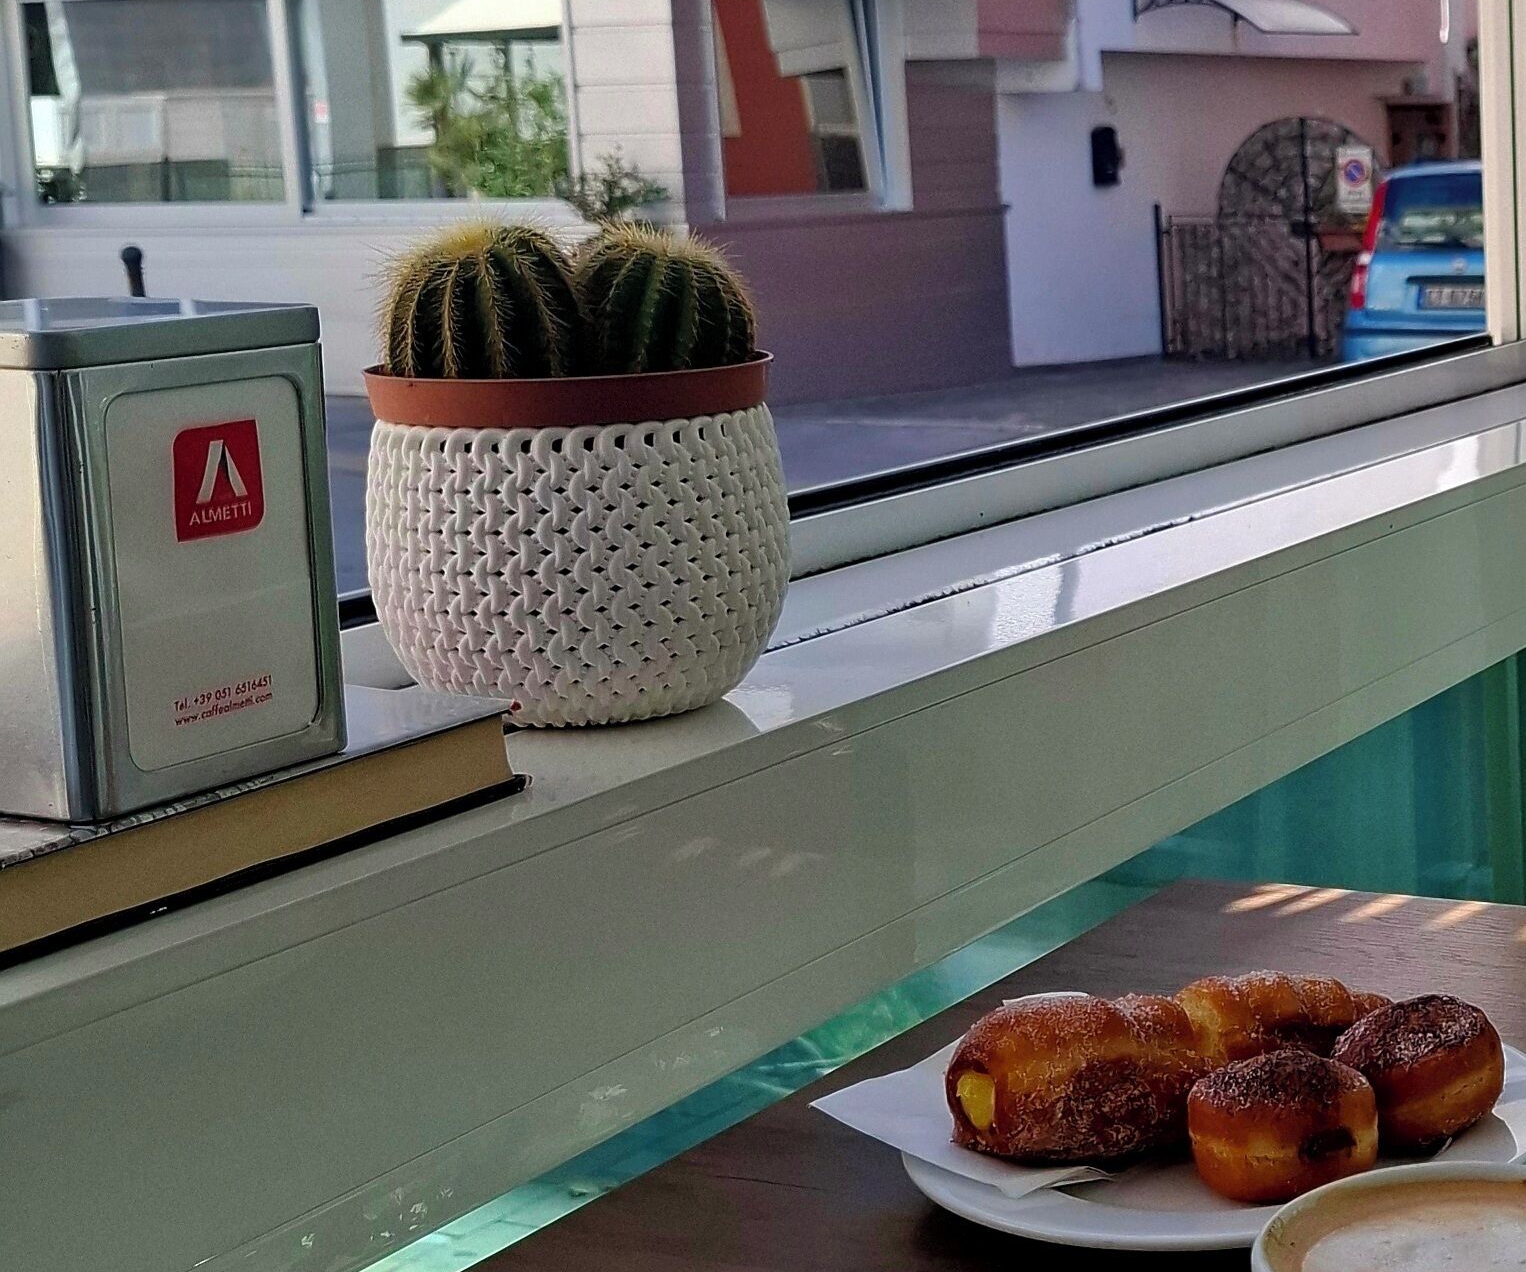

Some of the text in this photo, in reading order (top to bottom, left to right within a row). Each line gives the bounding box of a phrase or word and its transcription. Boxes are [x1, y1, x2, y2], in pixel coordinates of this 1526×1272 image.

[188, 501, 252, 526] ALMETTI
[174, 698, 191, 712] Tel.
[193, 692, 212, 706] +39
[215, 687, 231, 700] 051
